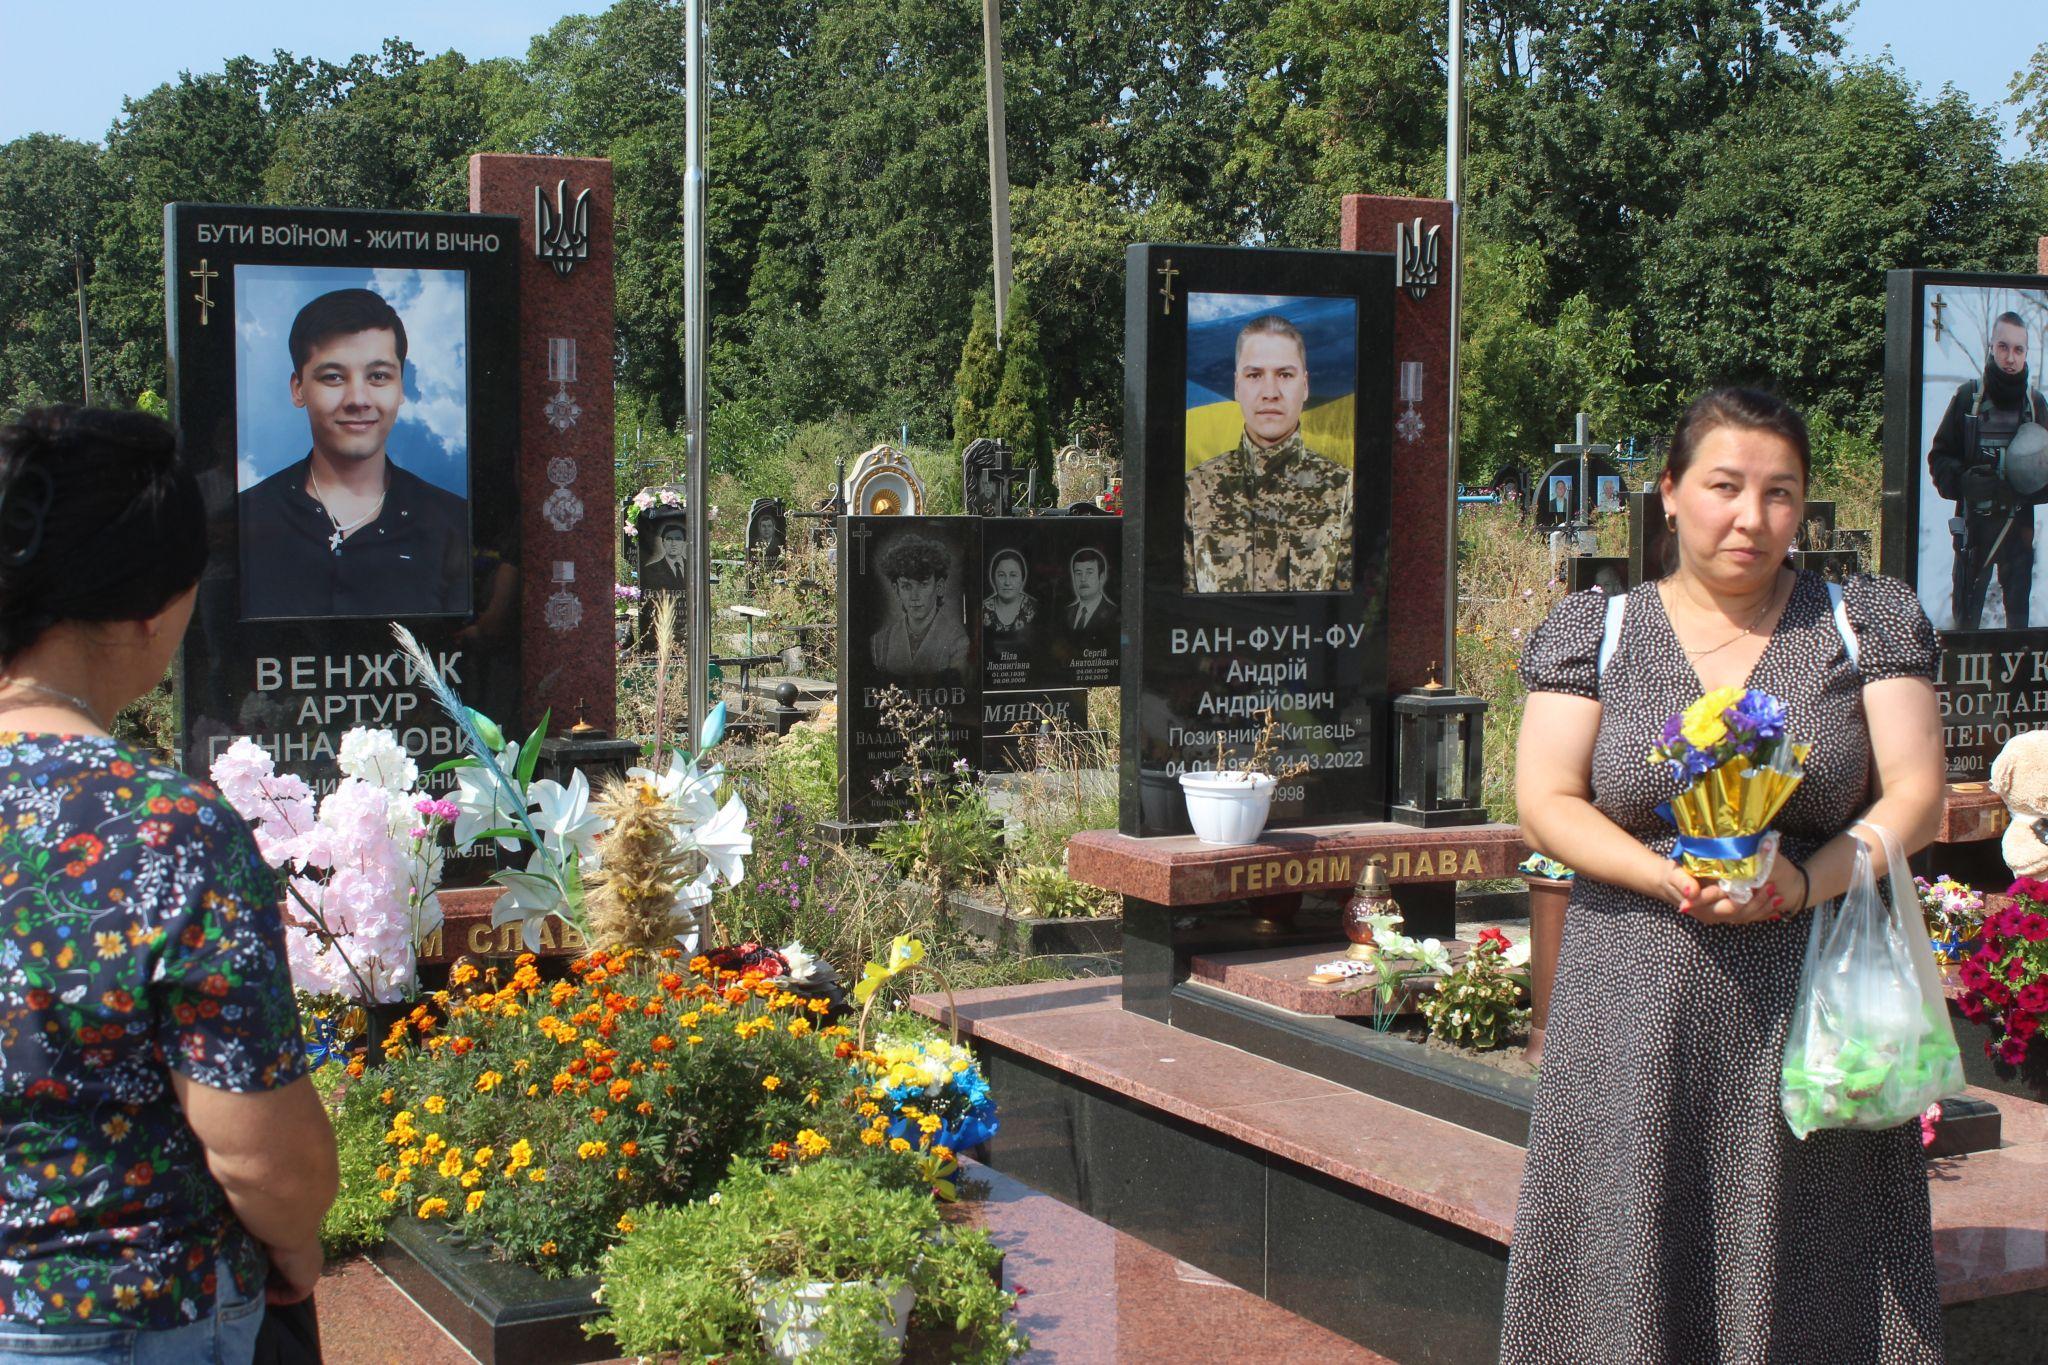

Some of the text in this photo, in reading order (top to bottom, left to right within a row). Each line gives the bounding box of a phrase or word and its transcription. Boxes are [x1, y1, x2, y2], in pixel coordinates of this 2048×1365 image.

[197, 224, 254, 245] БУТИ
[261, 224, 348, 248] ВОЇНОМ
[367, 230, 430, 250] ЖИТИ
[436, 232, 500, 252] ВІЧНО
[1171, 624, 1365, 654] ВАН-ФУН-ФУ
[256, 652, 463, 691] ВЕНЖИК
[1226, 658, 1308, 686] Андрій
[297, 693, 418, 725] АРТУР
[984, 702, 1070, 722] МЯНЮК
[1197, 689, 1334, 717] Андрійович
[1169, 725, 1262, 747] Позивний
[1230, 855, 1350, 893] ГЕРОЯМ
